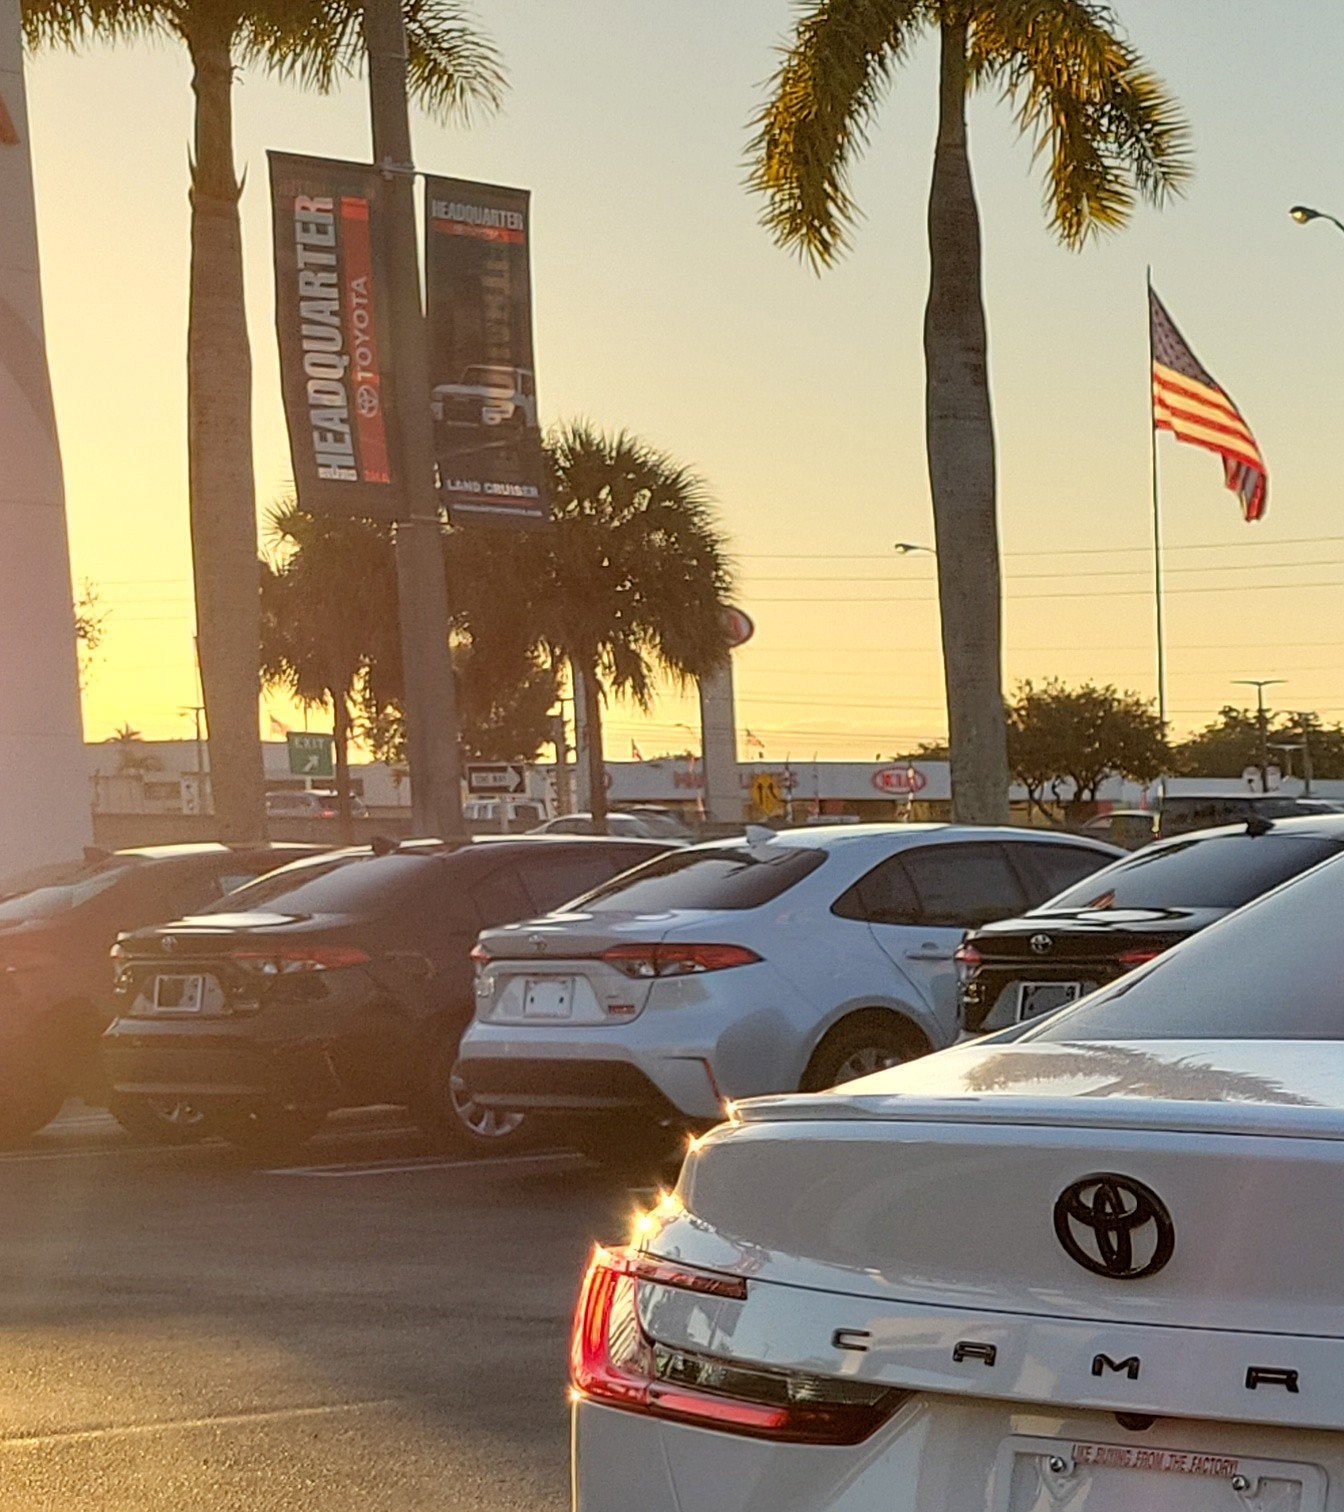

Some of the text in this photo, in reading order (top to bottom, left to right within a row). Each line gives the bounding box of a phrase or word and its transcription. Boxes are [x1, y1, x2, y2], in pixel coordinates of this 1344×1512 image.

[295, 194, 358, 482] HEADQUARTER
[351, 275, 374, 382] TOYOTA
[1135, 1449, 1164, 1471] FROM
[1168, 1452, 1188, 1474] THE
